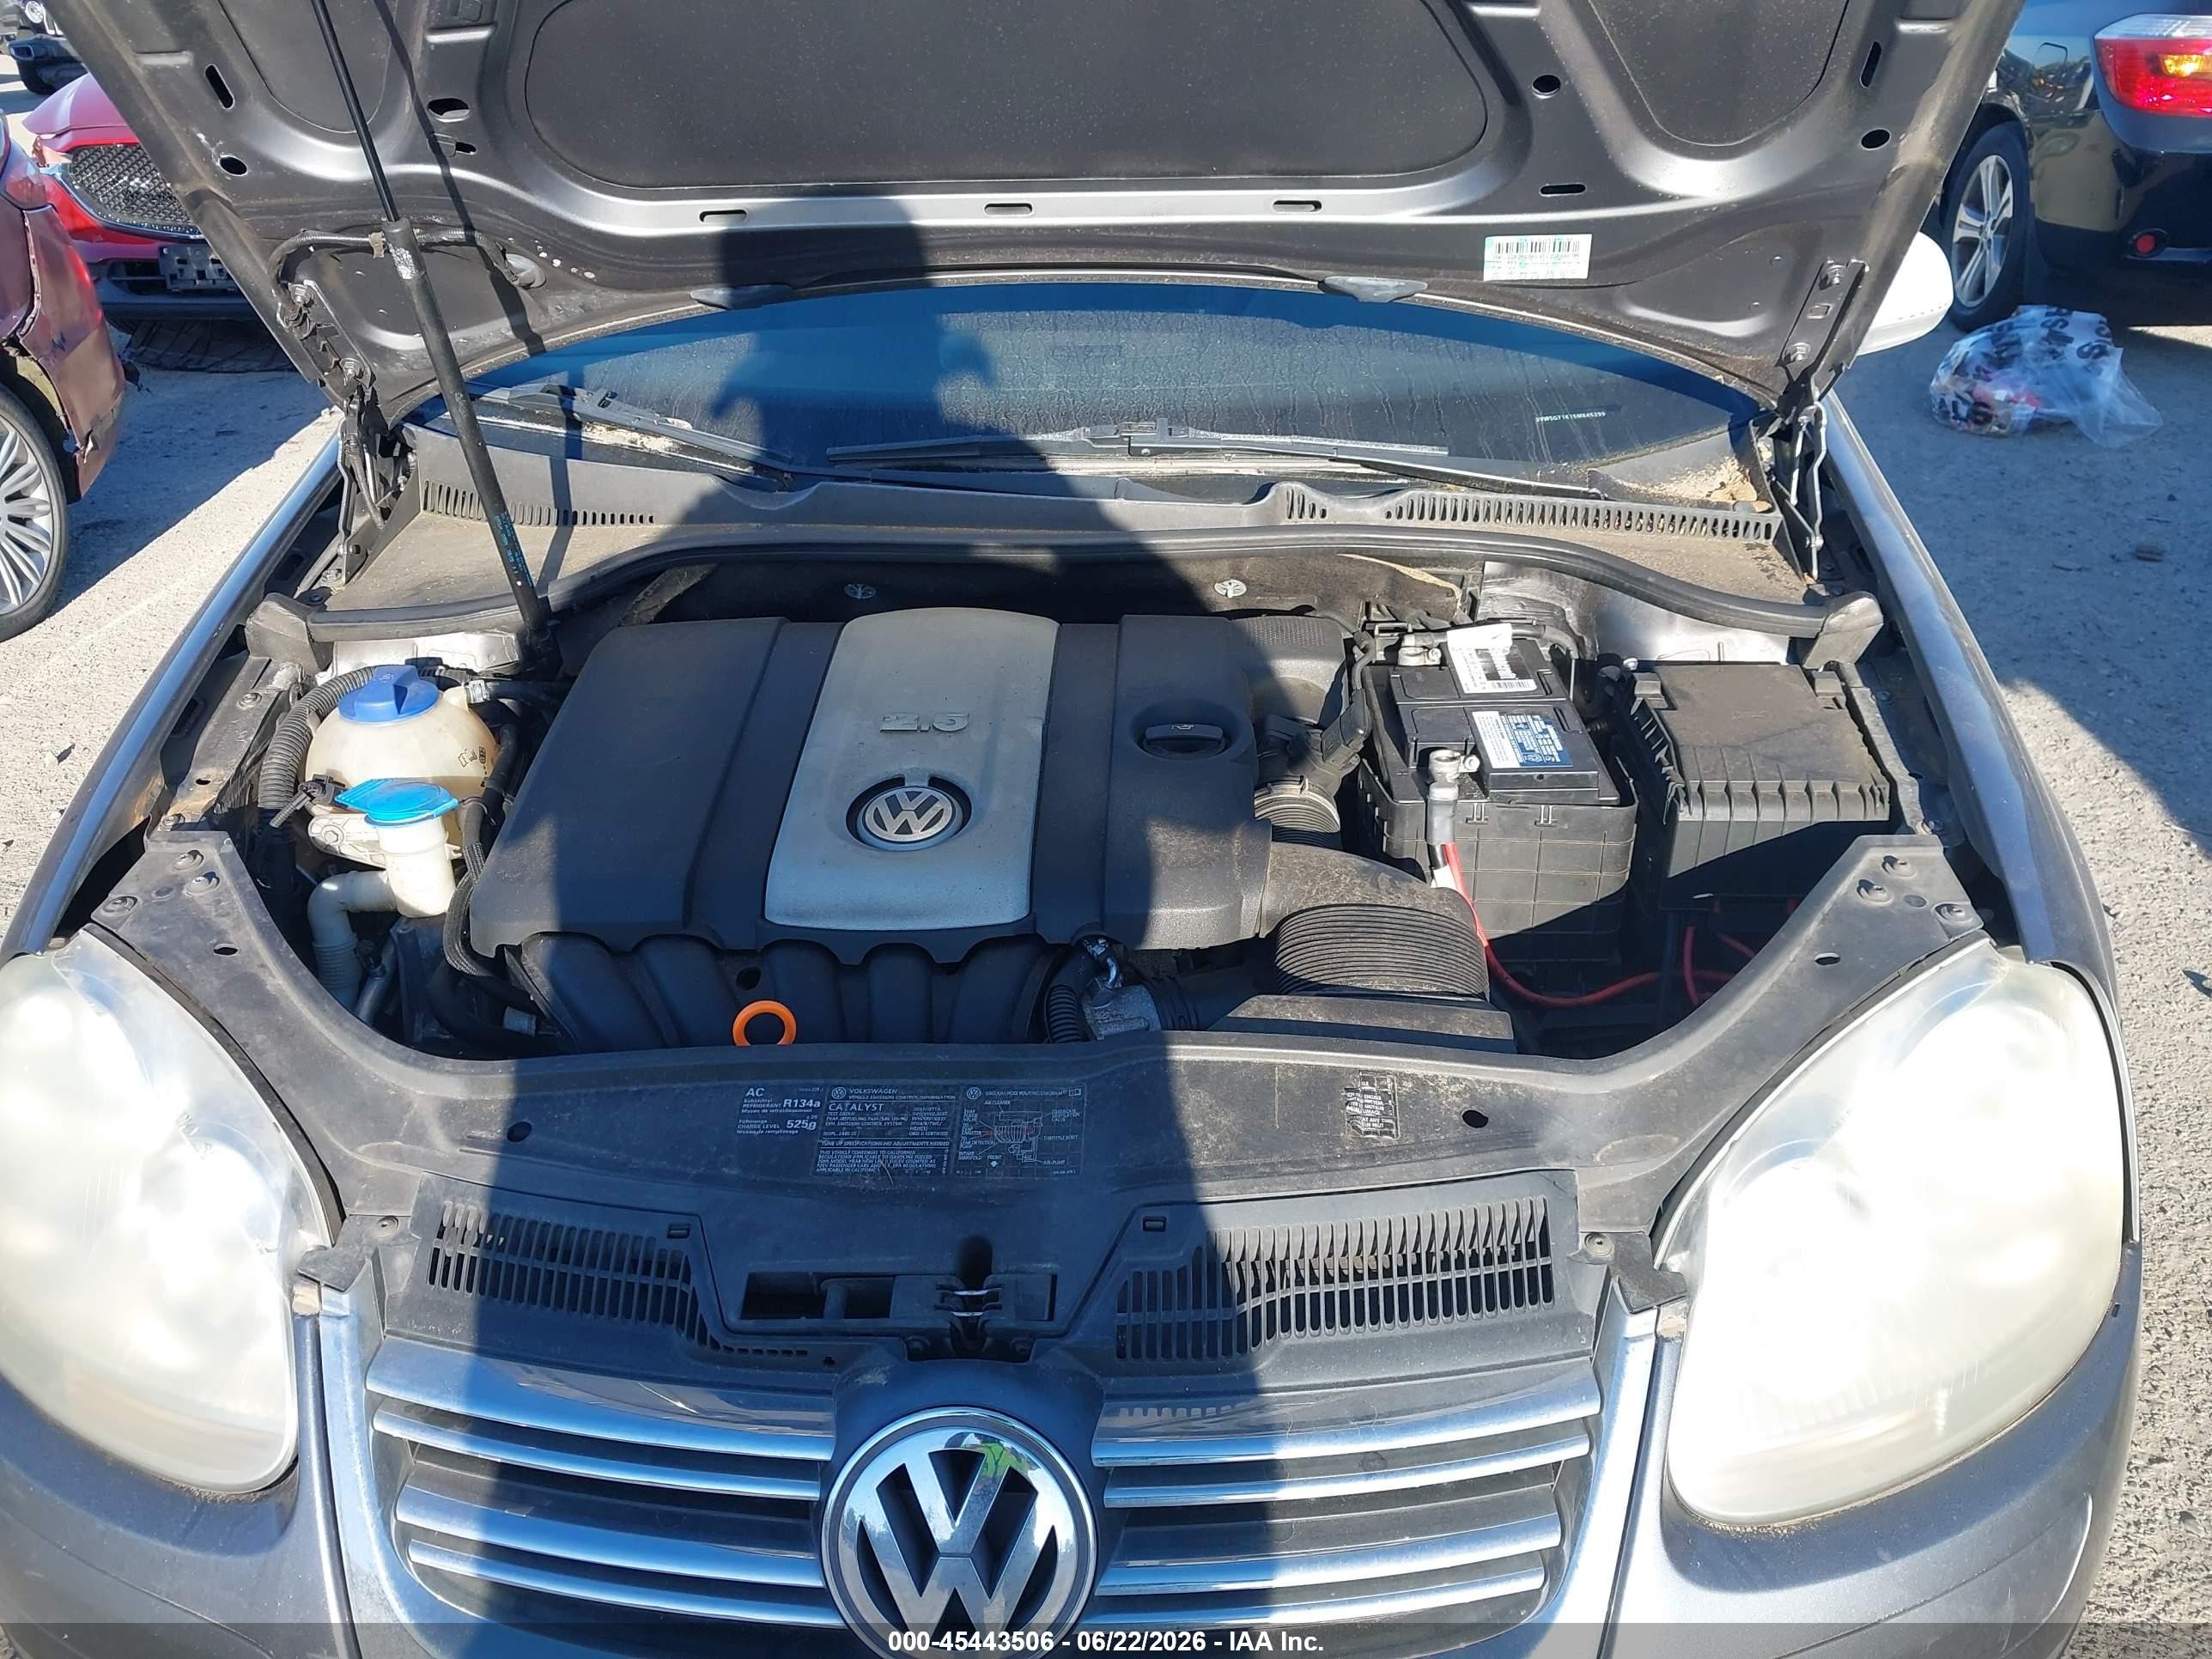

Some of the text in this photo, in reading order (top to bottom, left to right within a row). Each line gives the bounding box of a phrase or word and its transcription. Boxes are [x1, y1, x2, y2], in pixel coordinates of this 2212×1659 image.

[880, 713, 969, 732] 2.5
[746, 1087, 765, 1097] AC
[783, 1098, 821, 1108] R134a
[829, 1103, 885, 1111] CATALYST
[786, 1119, 817, 1131] 525g
